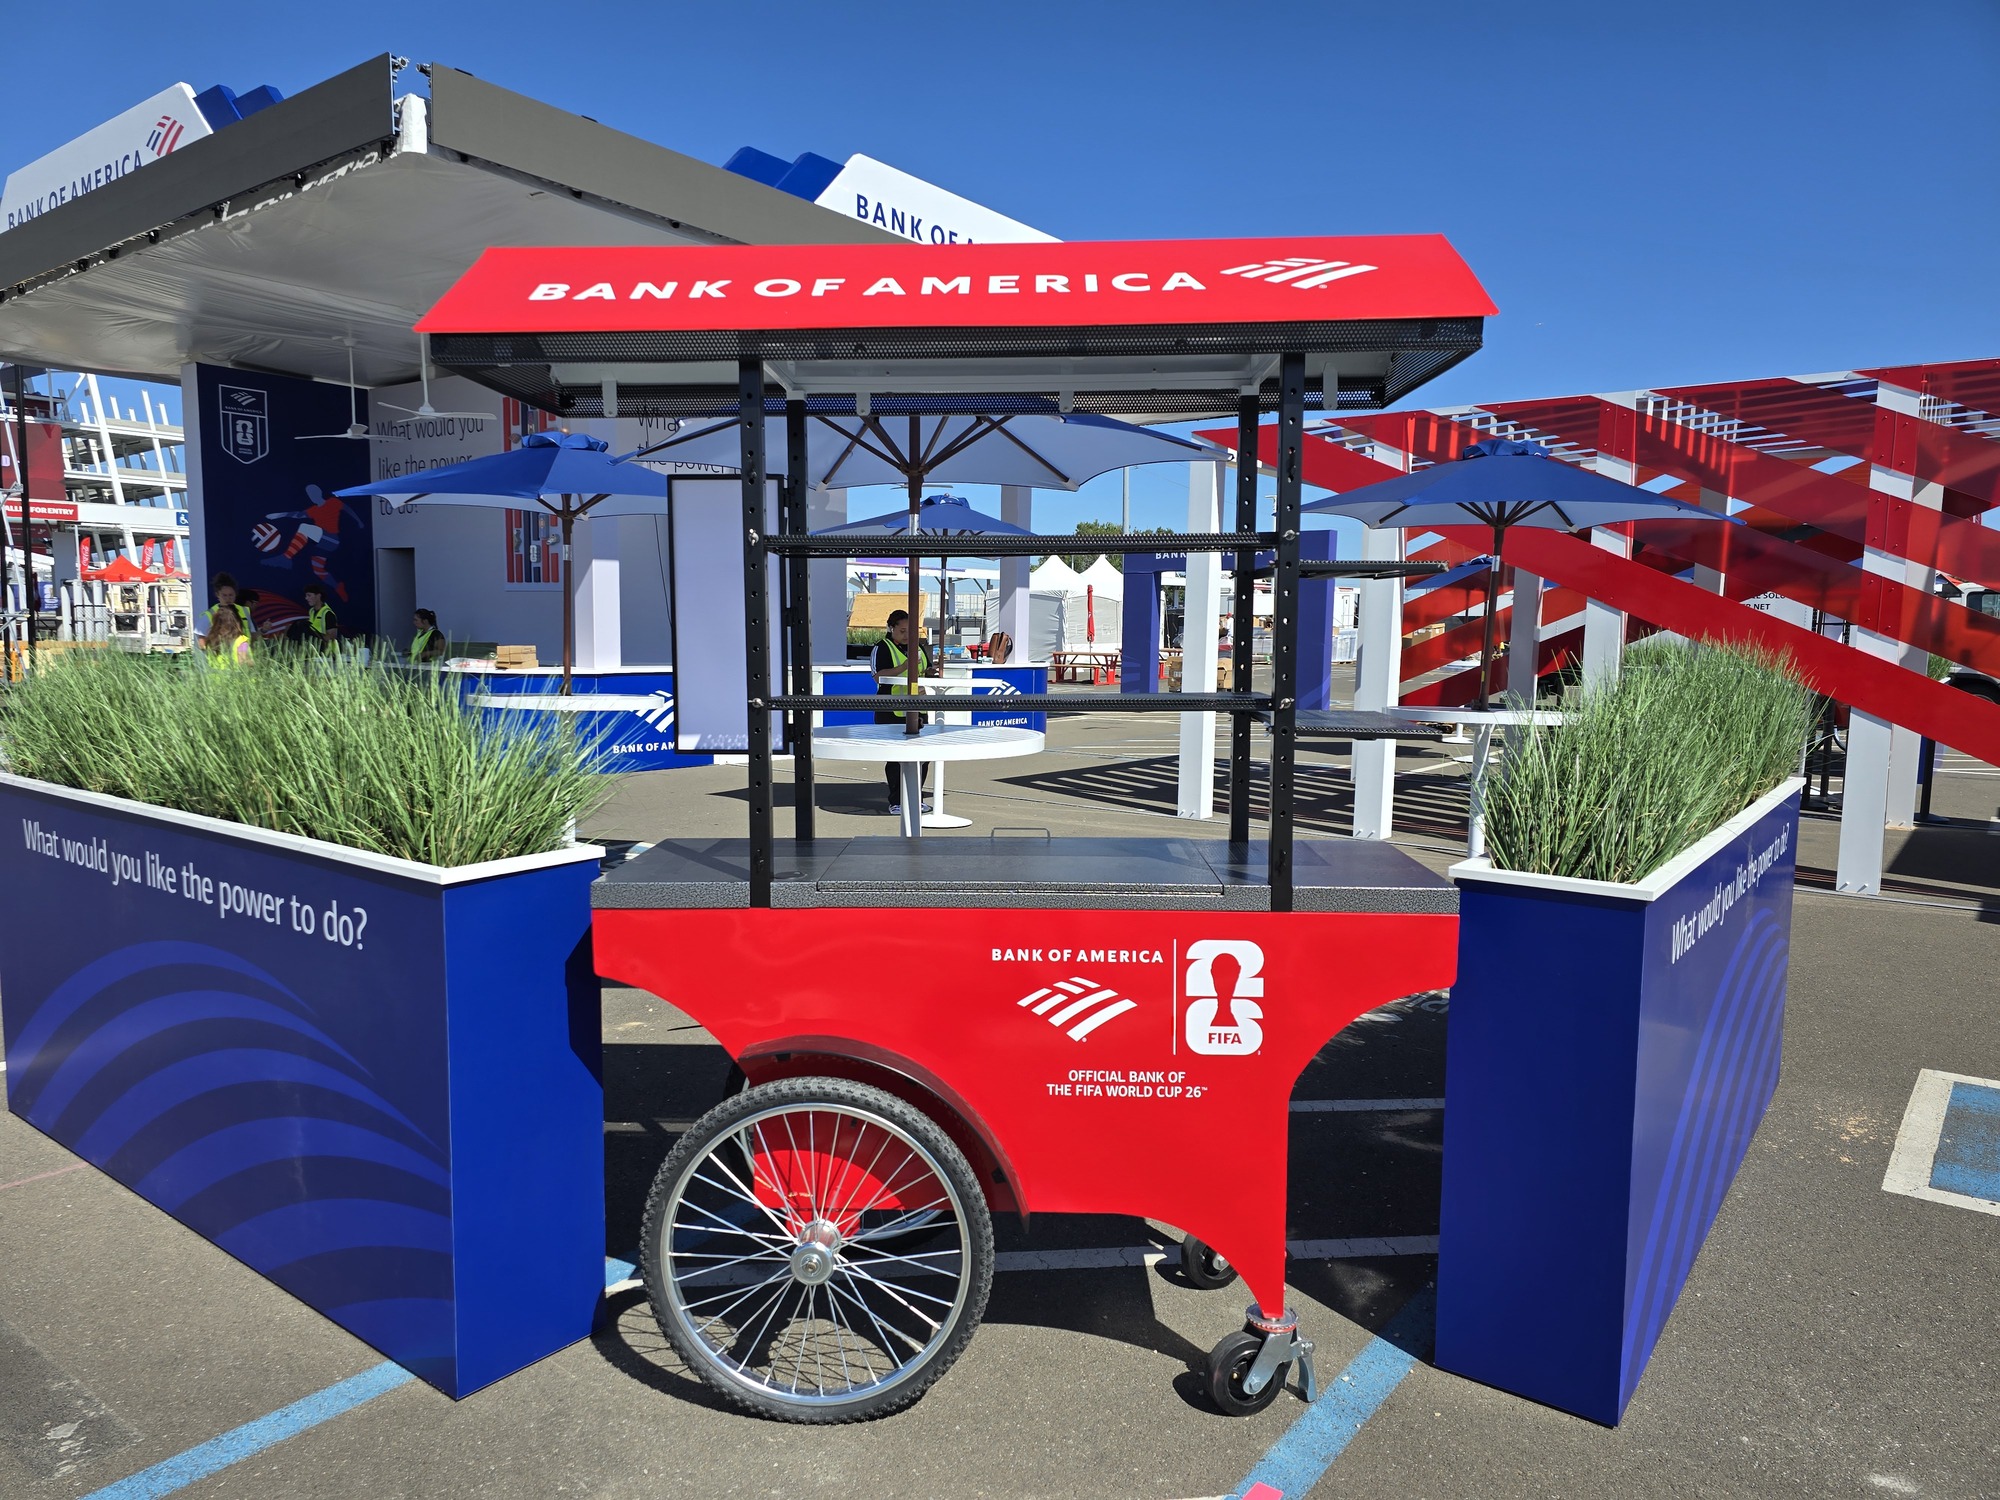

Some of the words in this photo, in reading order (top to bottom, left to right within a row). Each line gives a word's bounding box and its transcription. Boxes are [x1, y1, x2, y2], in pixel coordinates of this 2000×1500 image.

[8, 197, 44, 230] BANK
[48, 186, 66, 211] OF
[71, 149, 143, 201] AMERICA
[856, 193, 923, 242] BANK
[528, 279, 732, 300] BANK
[753, 278, 846, 297] OF
[862, 272, 1207, 296] AMERICA
[376, 419, 412, 443] What
[459, 417, 483, 441] you
[378, 457, 400, 480] like
[47, 507, 74, 515] ENTRY
[613, 743, 643, 753] BANK
[645, 742, 659, 751] OF
[22, 818, 60, 859] What
[62, 837, 108, 874] would
[111, 851, 142, 886] you
[145, 851, 177, 894] like
[181, 862, 214, 905] the
[219, 881, 284, 925] power
[290, 895, 316, 935] to
[322, 900, 368, 950] do?
[1672, 911, 1697, 965] What
[1698, 881, 1722, 939] would
[1720, 880, 1735, 926] you
[1735, 863, 1747, 901] like
[1747, 854, 1757, 889] the
[1756, 843, 1775, 888] power
[1773, 836, 1780, 862] to
[1780, 822, 1790, 856] do?
[991, 948, 1043, 961] BANK
[1048, 949, 1072, 962] OF
[1076, 949, 1164, 963] AMERICA
[1207, 1032, 1242, 1044] FIFA
[1068, 1069, 1126, 1083] OFFICIAL
[1129, 1070, 1165, 1083] BANK
[1168, 1071, 1186, 1083] OF
[1046, 1083, 1072, 1096] THE
[1075, 1084, 1101, 1097] FIFA
[1102, 1084, 1153, 1098] WORLD
[1156, 1085, 1182, 1098] CUP
